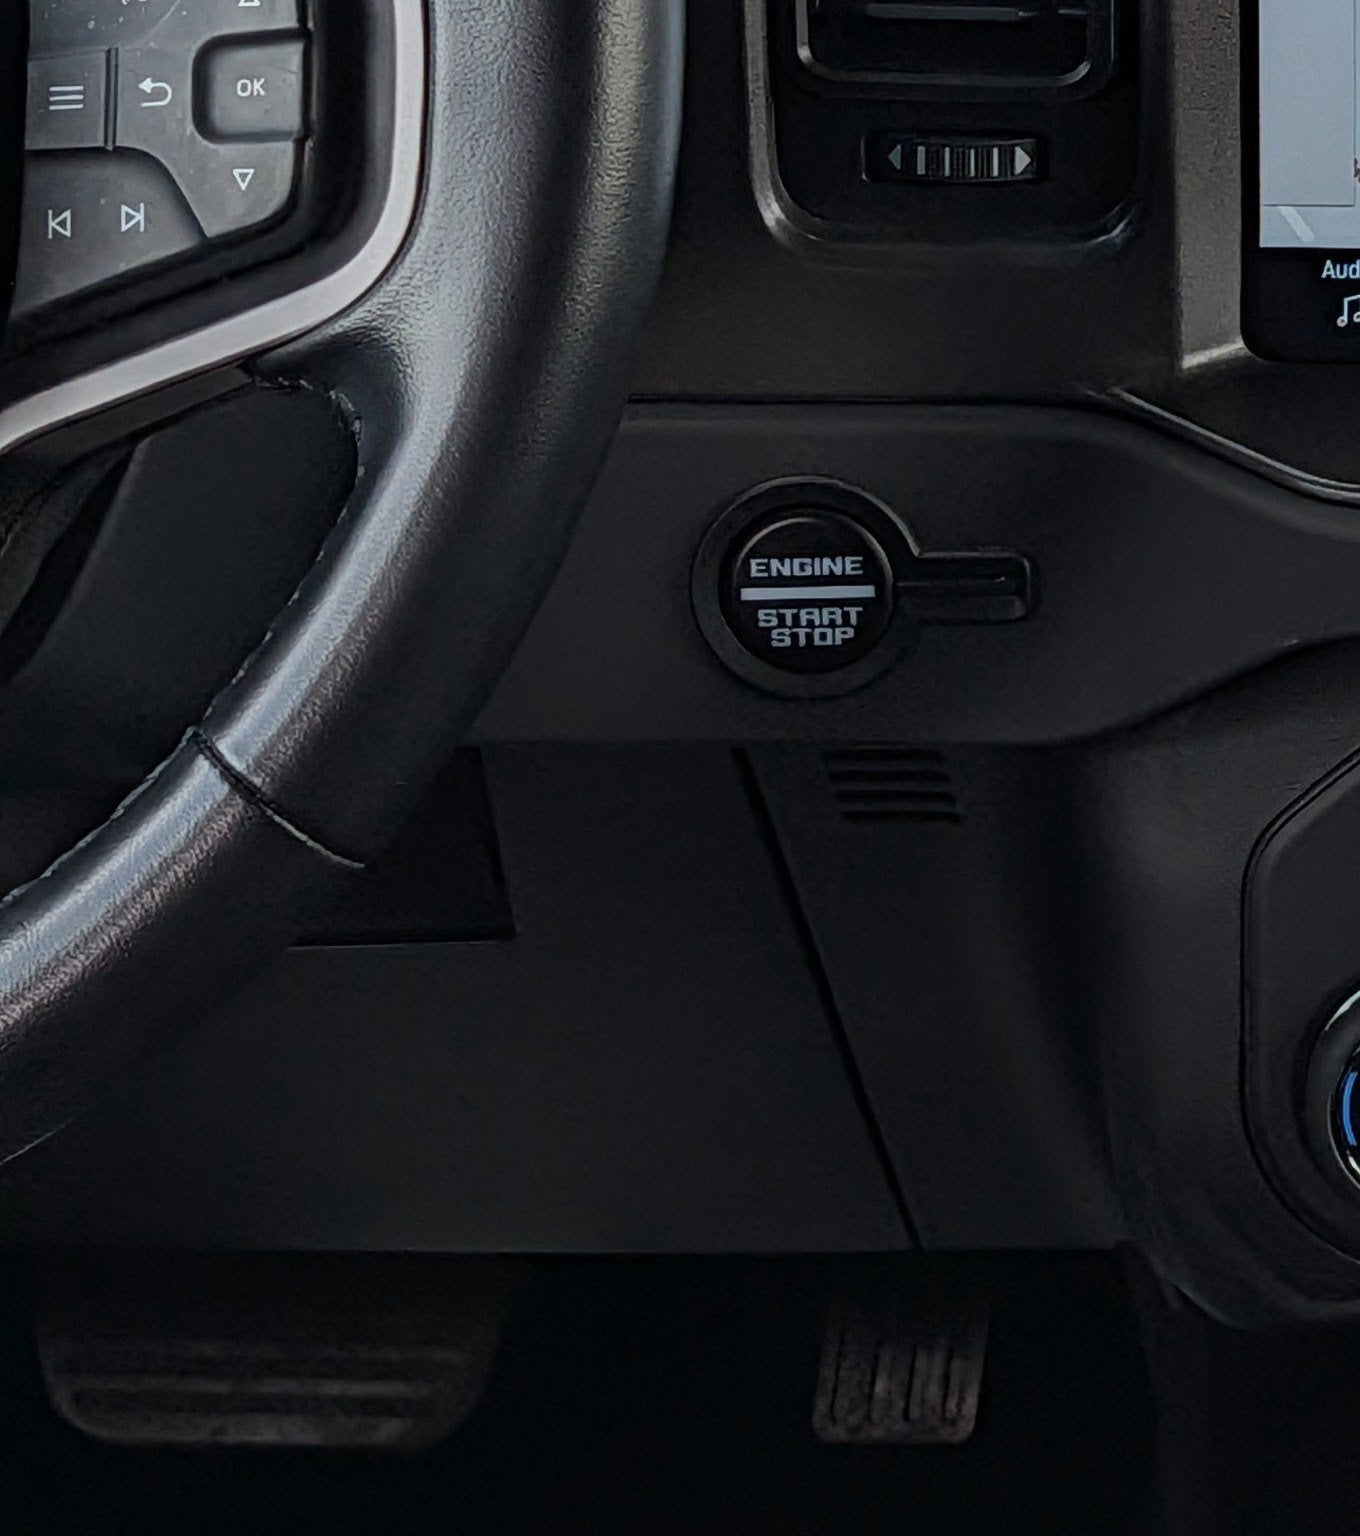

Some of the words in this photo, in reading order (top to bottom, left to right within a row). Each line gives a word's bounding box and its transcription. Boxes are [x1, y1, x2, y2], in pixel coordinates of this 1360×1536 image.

[236, 77, 266, 98] OK
[750, 556, 864, 578] ENGINE
[758, 607, 863, 627] START
[771, 627, 855, 647] STOP
